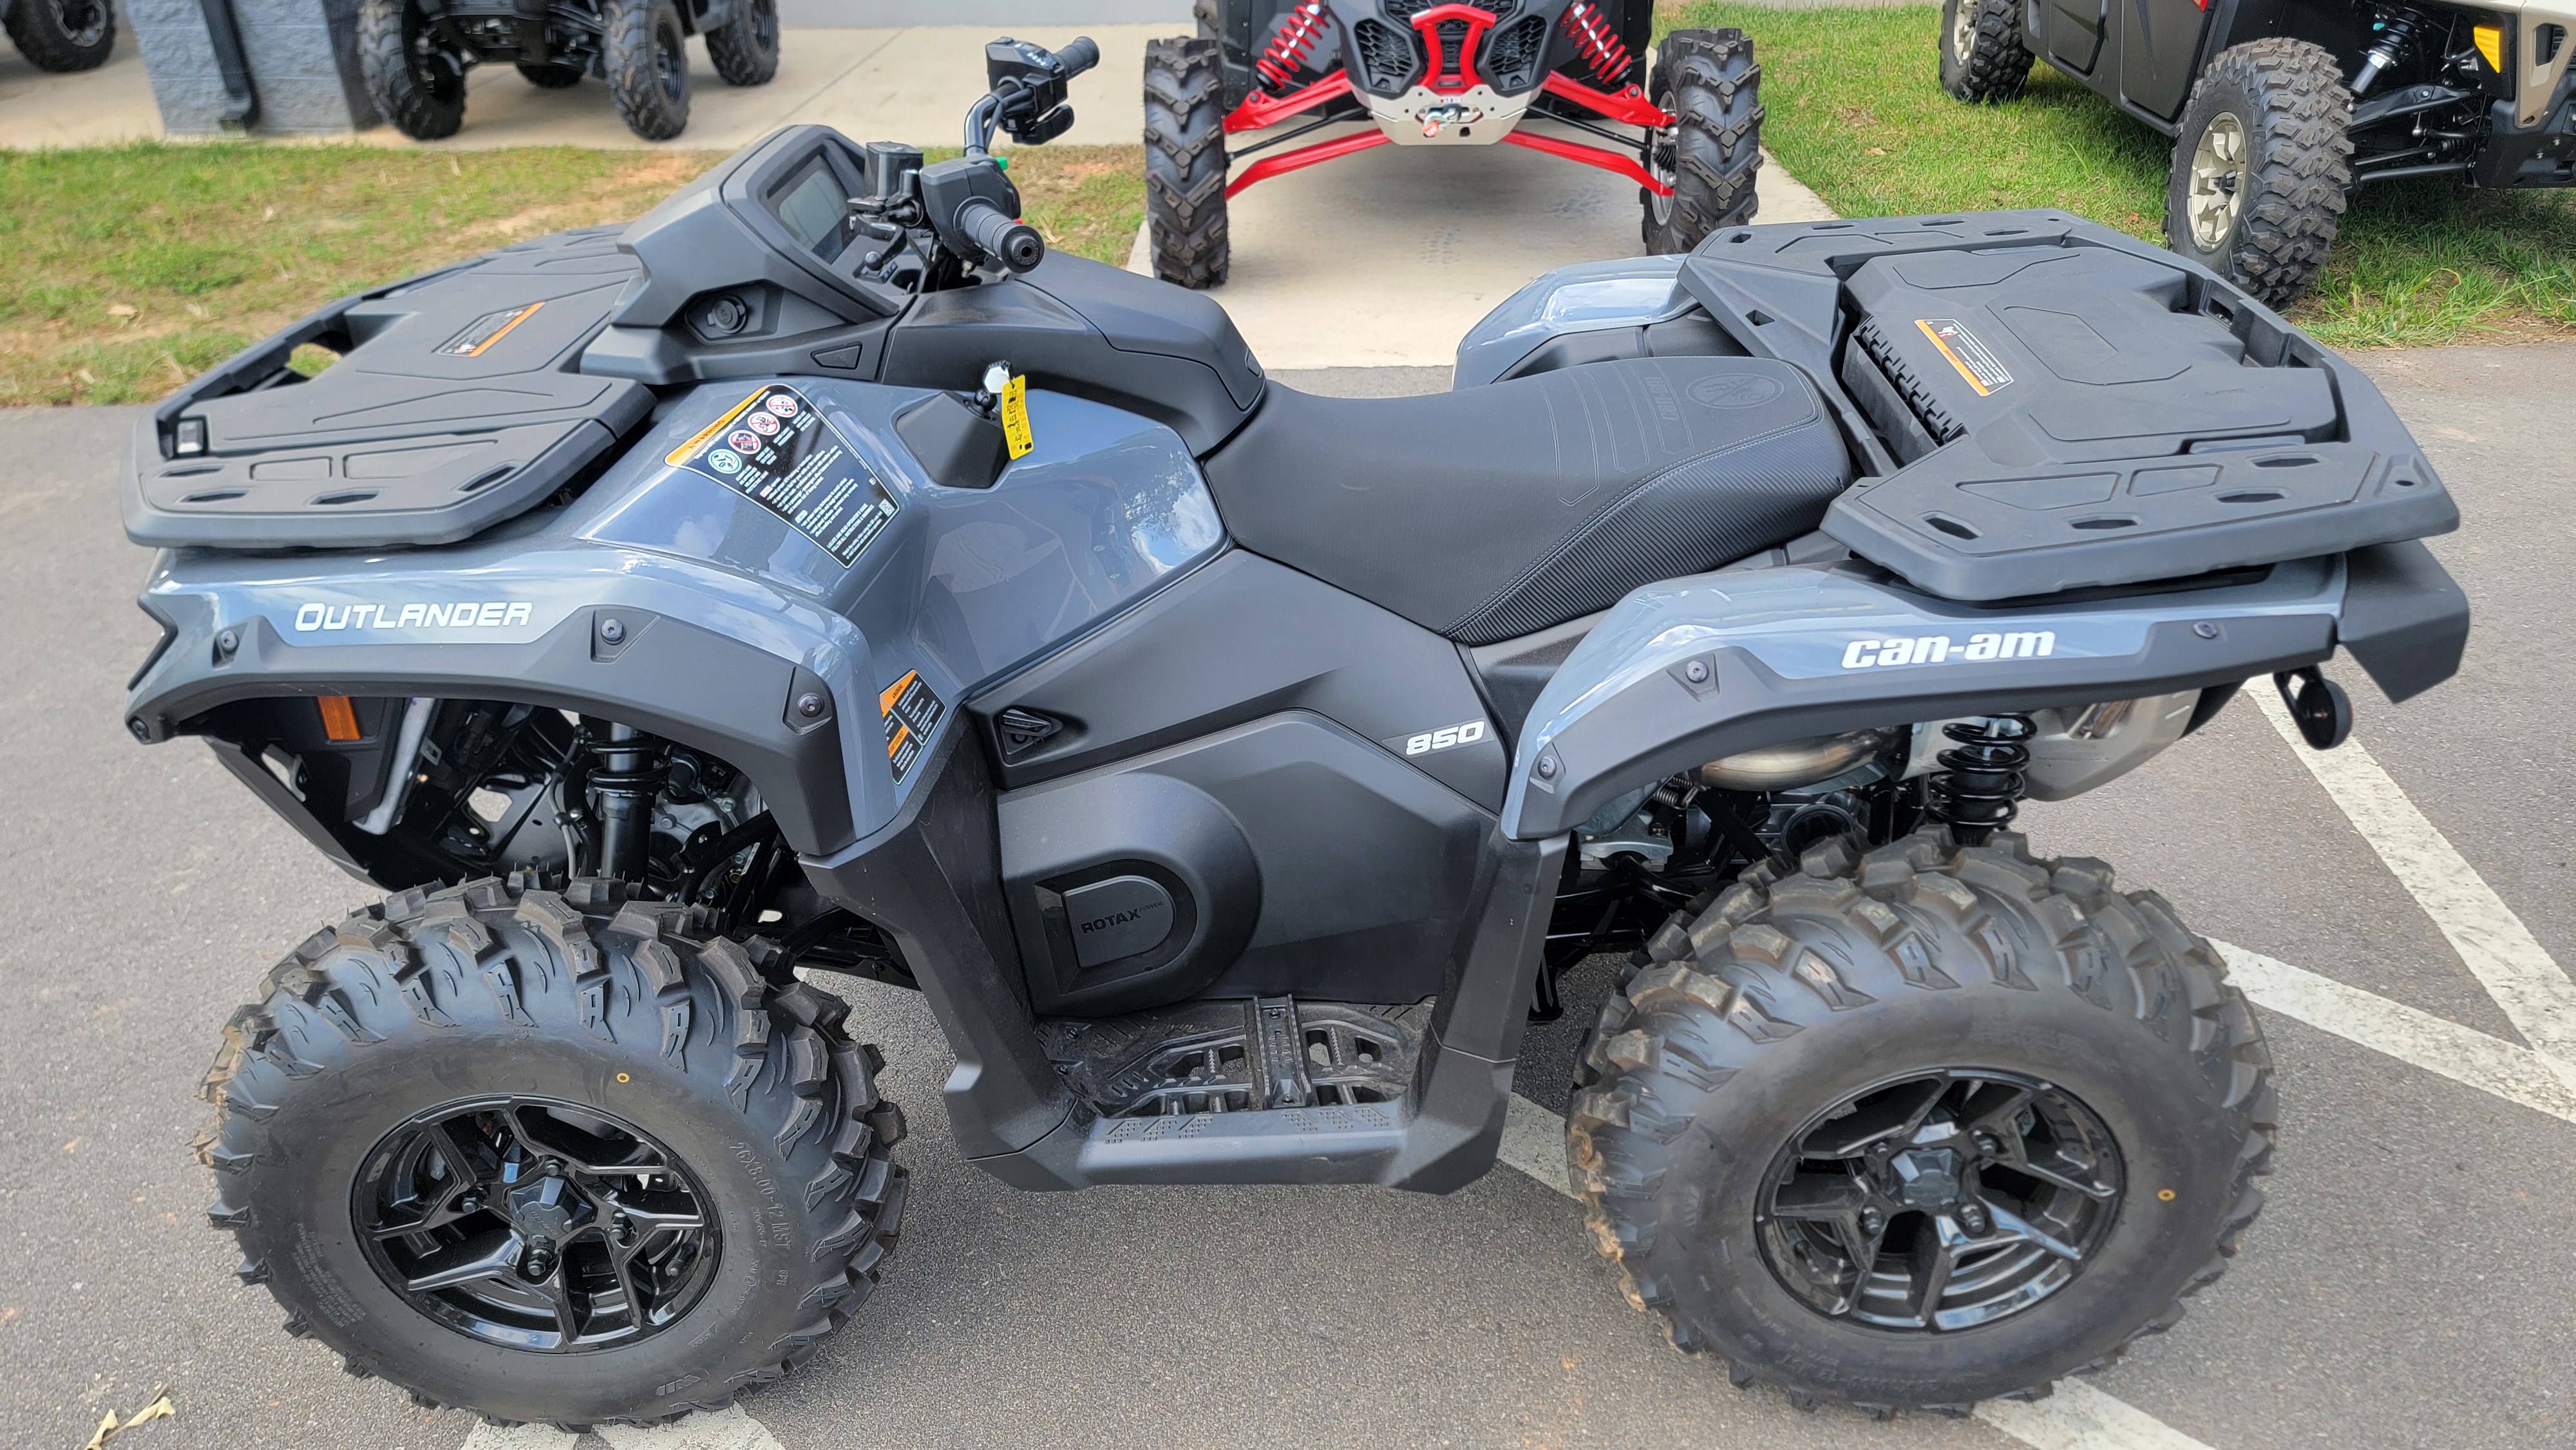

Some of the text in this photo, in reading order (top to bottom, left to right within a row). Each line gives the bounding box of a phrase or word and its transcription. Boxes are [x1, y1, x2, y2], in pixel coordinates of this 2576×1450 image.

[294, 602, 533, 632] OUTLANDER
[1406, 720, 1485, 755] 850
[1081, 901, 1163, 934] ROTAX POWER
